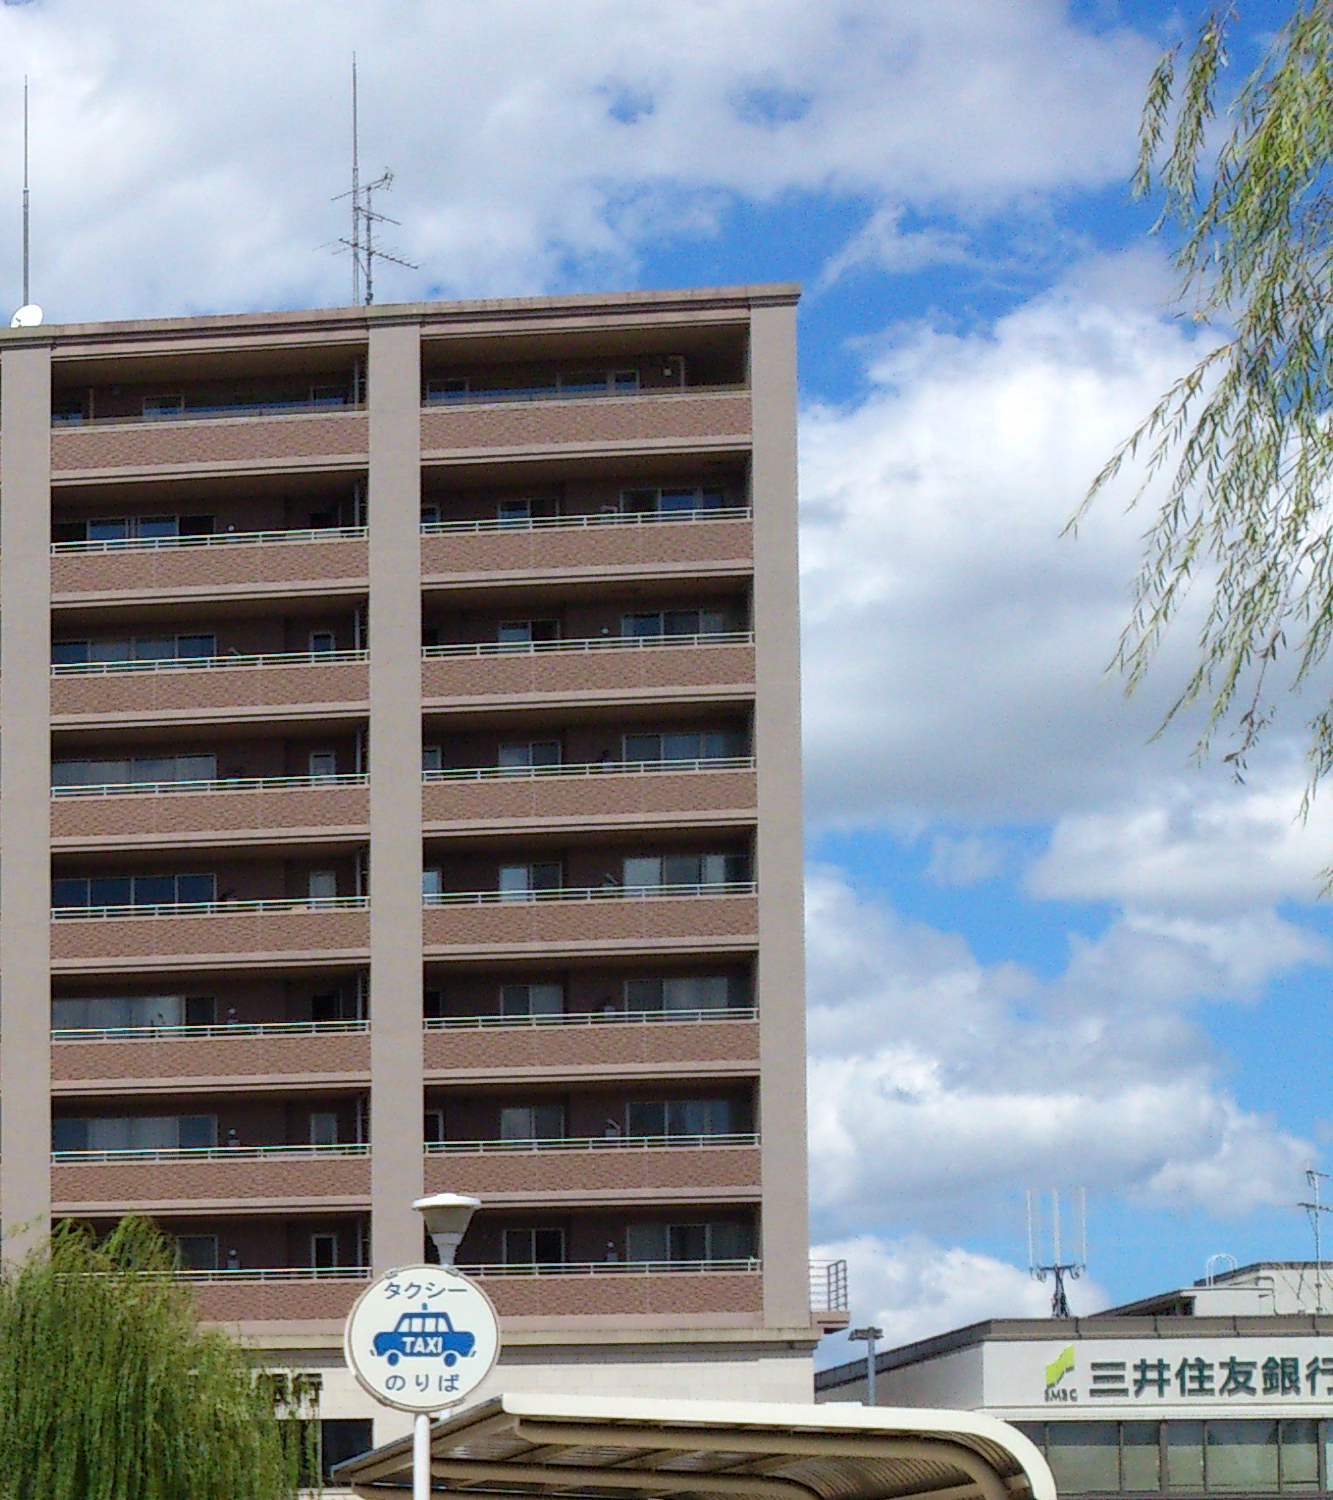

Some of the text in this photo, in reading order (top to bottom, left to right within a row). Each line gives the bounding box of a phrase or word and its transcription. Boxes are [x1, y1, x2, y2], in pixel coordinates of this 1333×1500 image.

[384, 1281, 468, 1300] タクシー
[401, 1337, 444, 1354] TAXI
[385, 1374, 460, 1392] のりば
